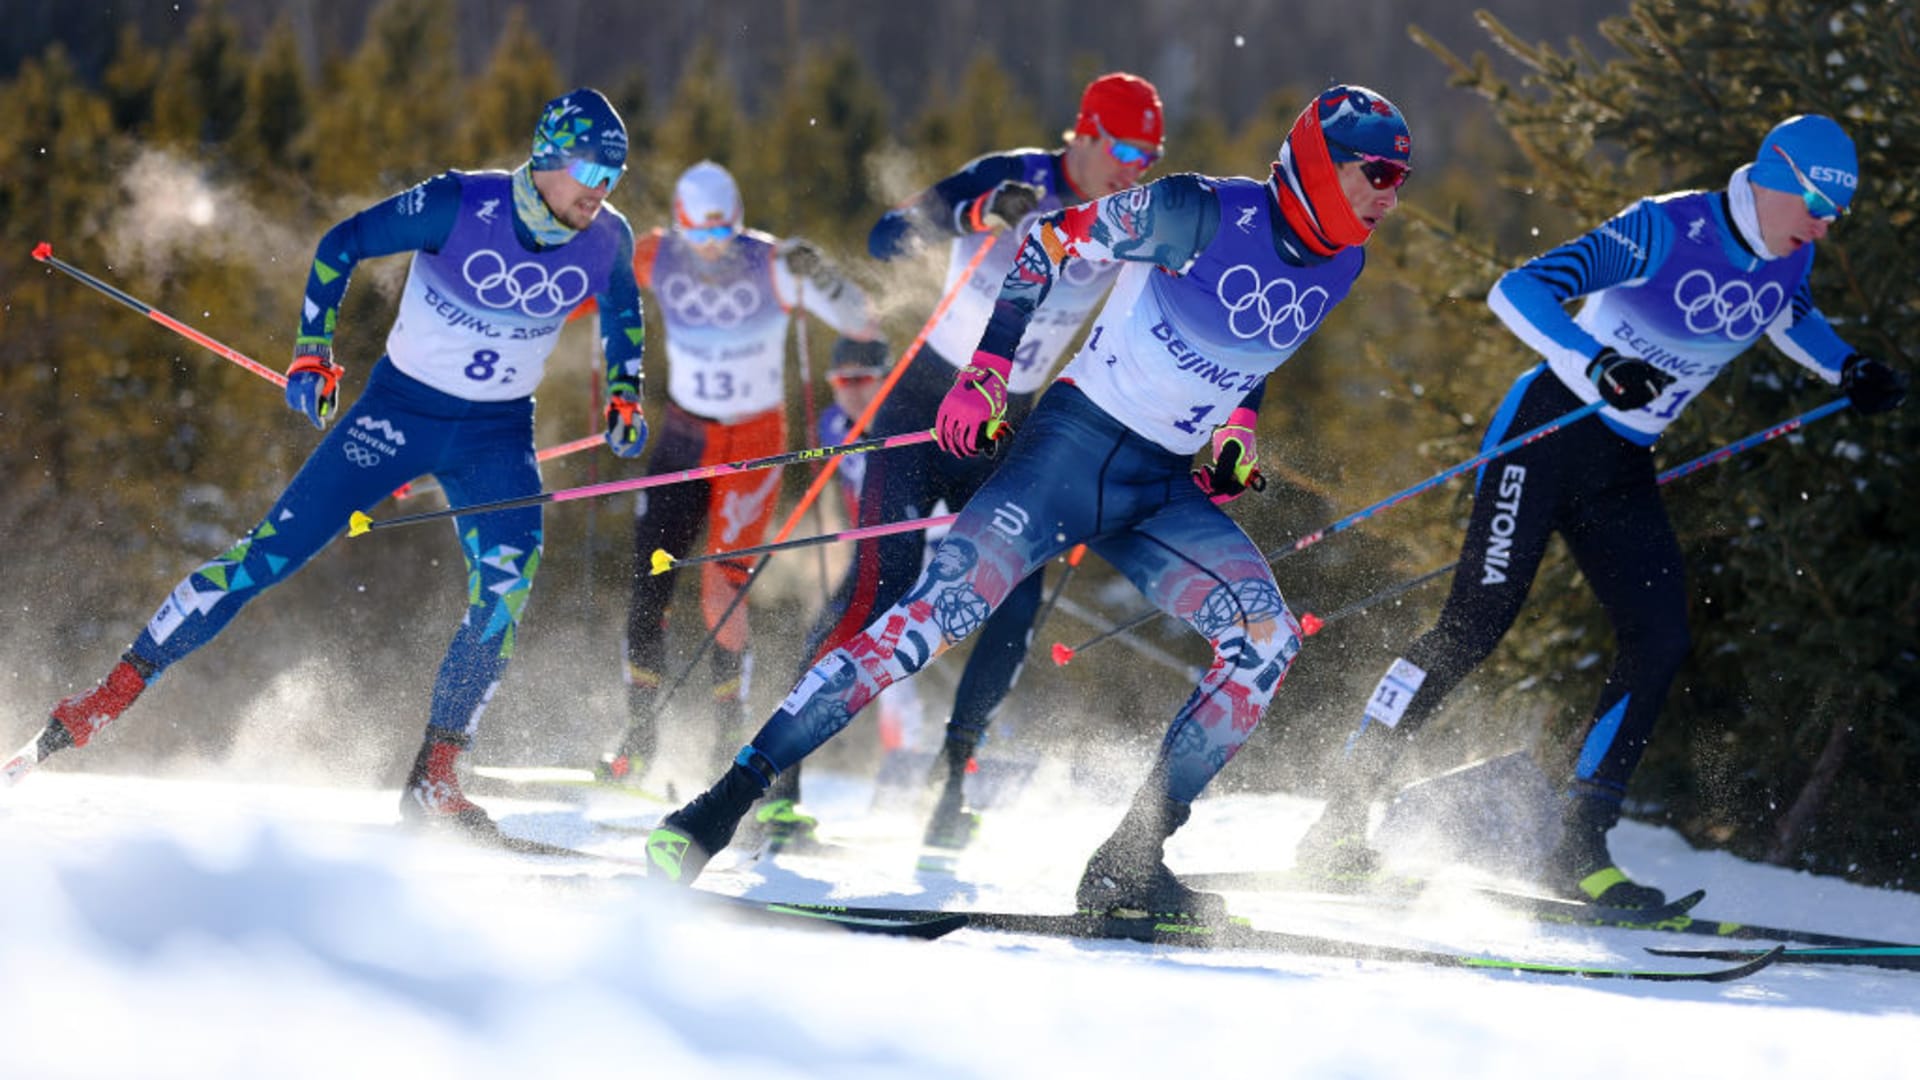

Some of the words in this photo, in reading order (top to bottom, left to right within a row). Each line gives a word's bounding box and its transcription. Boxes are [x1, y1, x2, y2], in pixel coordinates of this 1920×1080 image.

[425, 285, 501, 338] BEIJING
[1151, 318, 1241, 391] BEIJING
[1613, 319, 1700, 376] BEIJING
[464, 349, 500, 381] 8
[500, 367, 517, 384] 2
[693, 370, 735, 401] 13
[1174, 404, 1215, 434] 1
[347, 427, 397, 457] SLOVENIA
[1481, 464, 1526, 585] ESTONIA
[1375, 685, 1398, 709] 11
